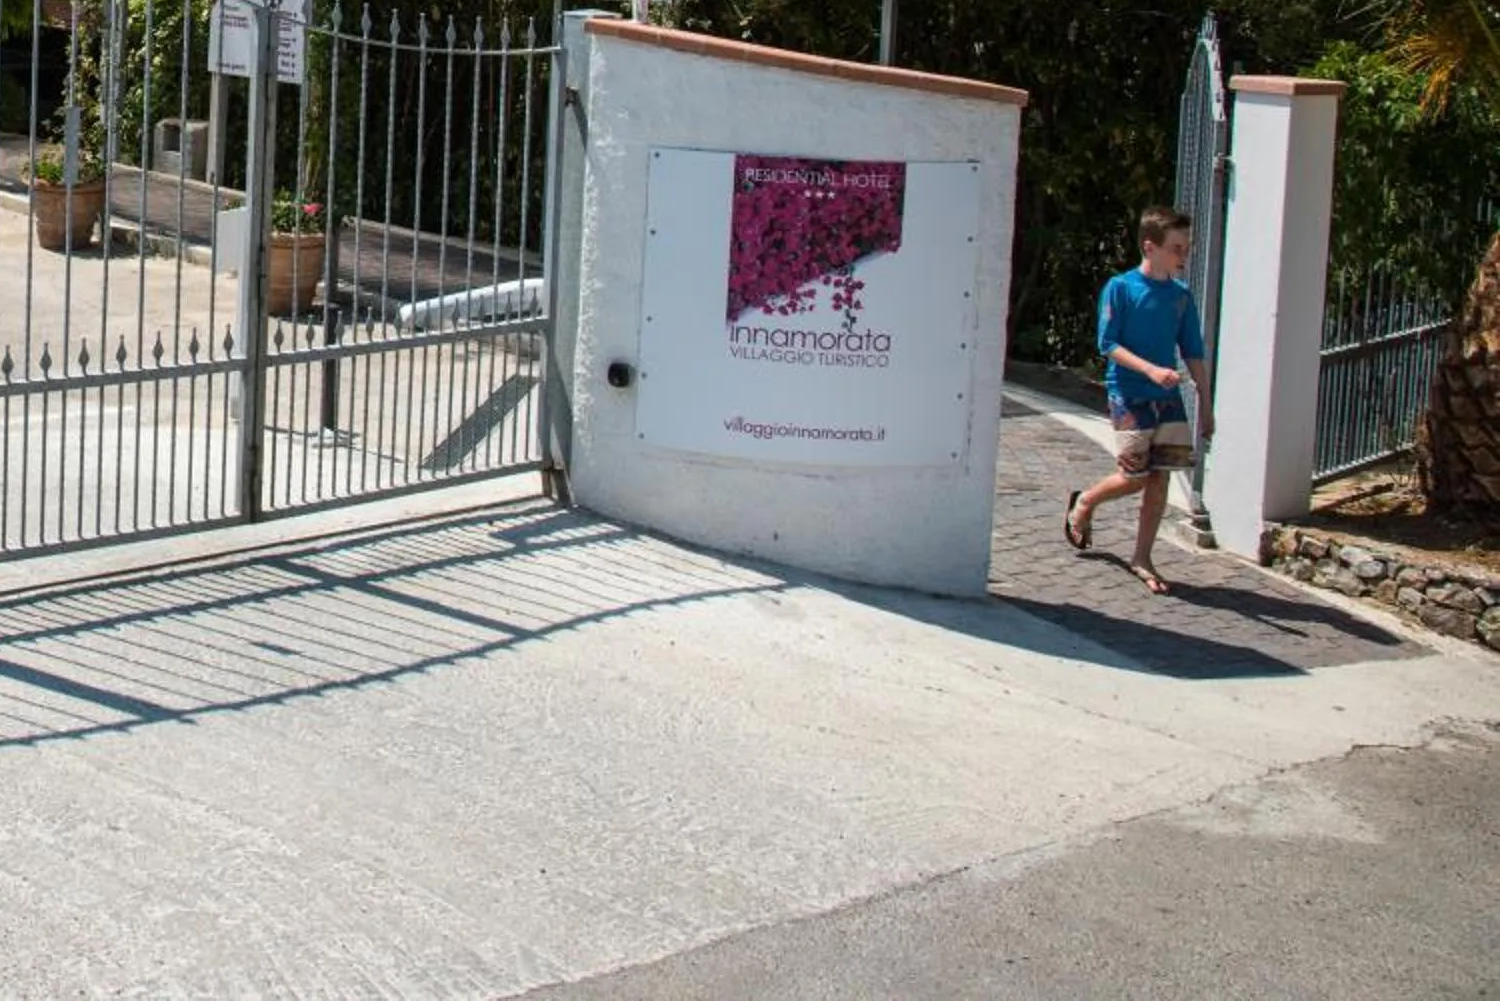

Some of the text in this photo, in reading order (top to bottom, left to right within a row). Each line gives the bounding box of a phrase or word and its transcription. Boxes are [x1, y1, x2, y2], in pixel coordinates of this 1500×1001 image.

[744, 167, 837, 186] RESIDENTIAL
[729, 323, 891, 352] innamorata
[729, 348, 890, 367] VILLAGGIO TURISTICO
[723, 415, 886, 440] villaggioinnamorata.it
